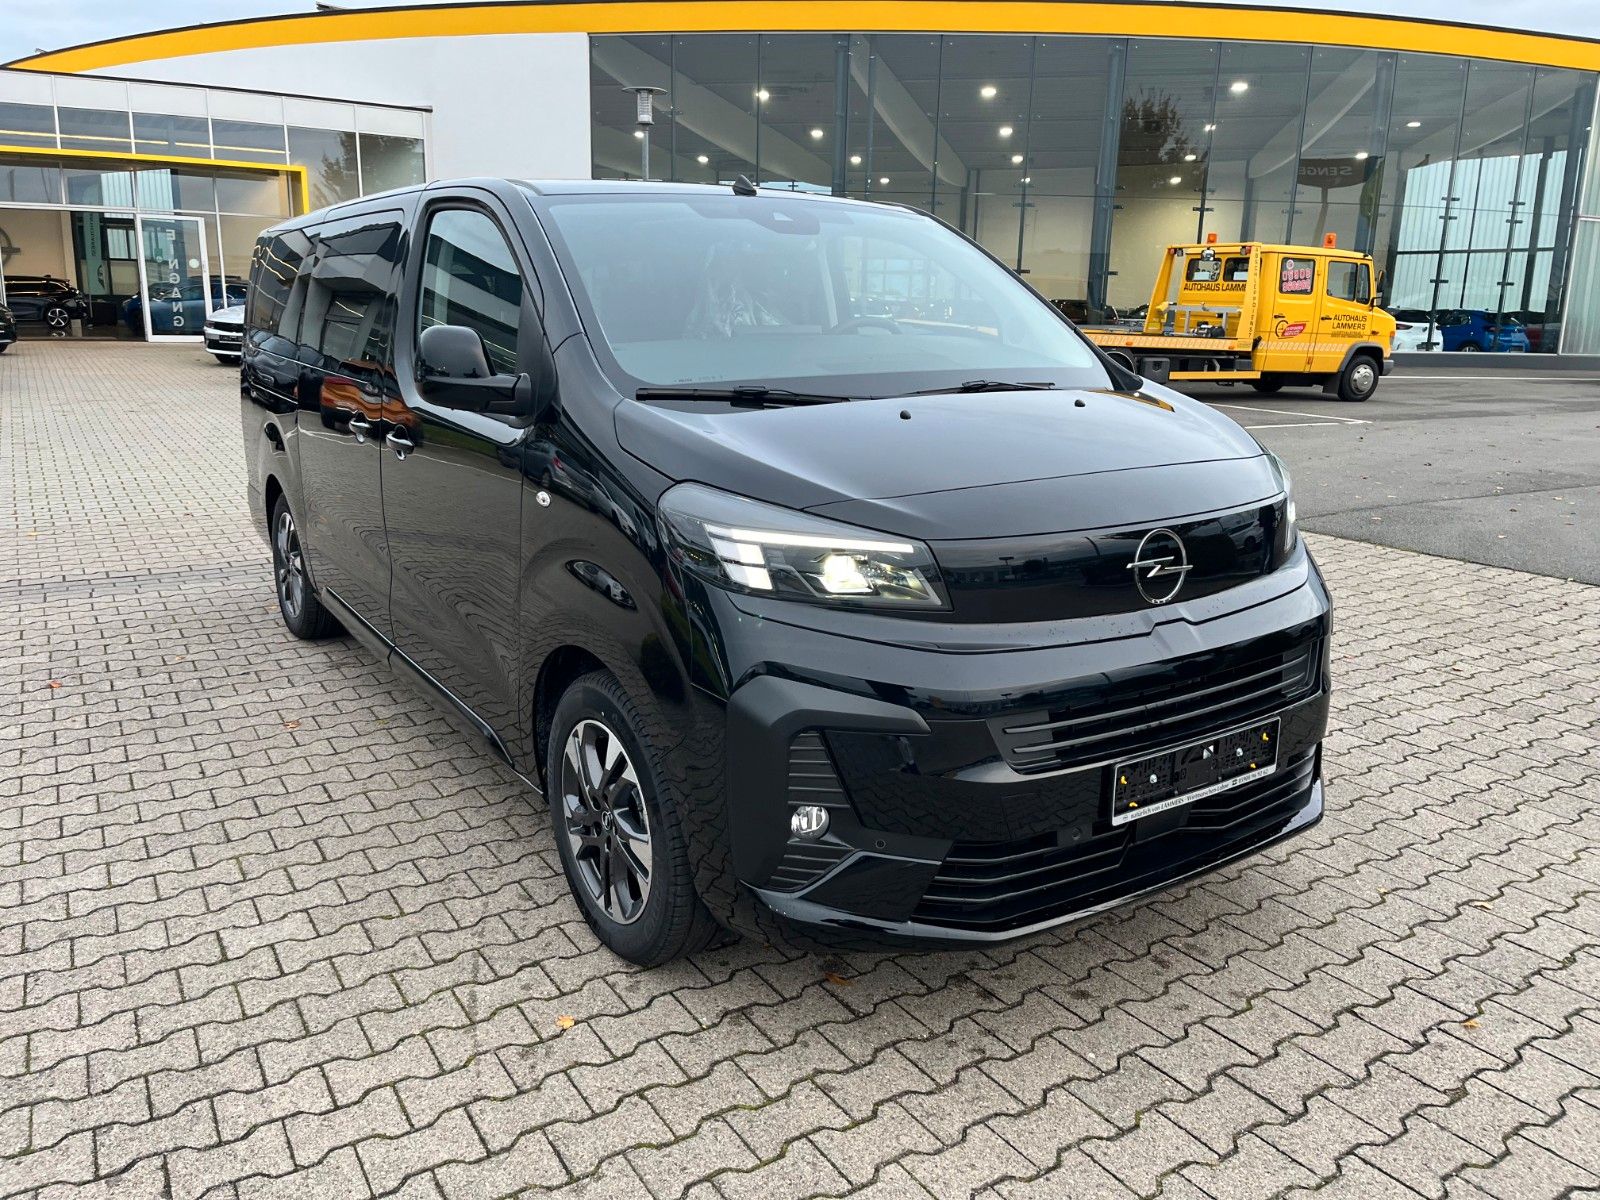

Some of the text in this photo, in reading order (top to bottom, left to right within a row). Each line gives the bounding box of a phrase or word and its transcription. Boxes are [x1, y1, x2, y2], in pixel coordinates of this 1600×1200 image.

[1184, 282, 1221, 292] AUTOHAUS
[1333, 314, 1368, 323] AUTOHAUS
[1331, 322, 1367, 331] LAMMERS
[1160, 798, 1184, 811] LAMMERS
